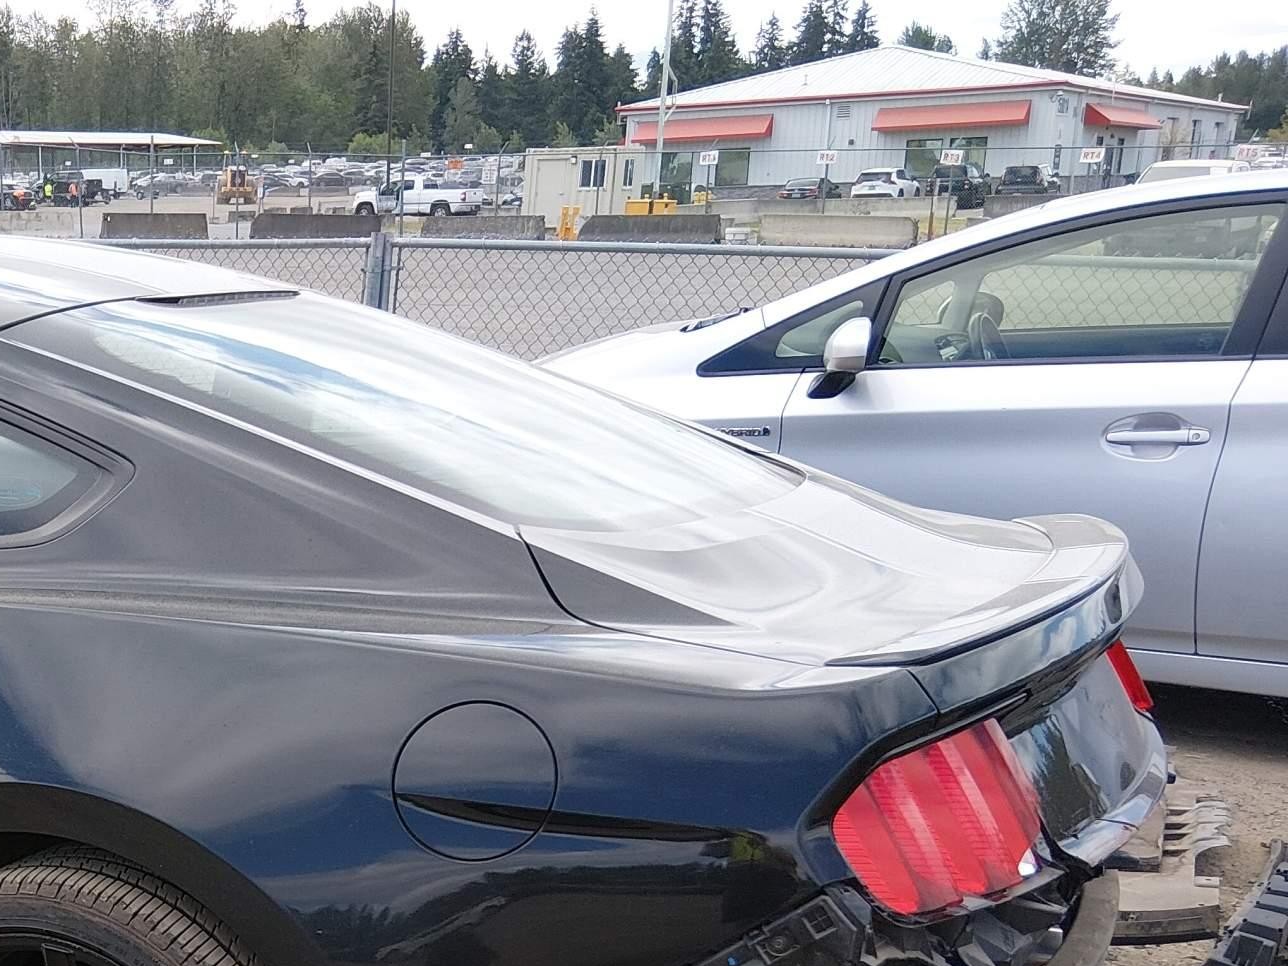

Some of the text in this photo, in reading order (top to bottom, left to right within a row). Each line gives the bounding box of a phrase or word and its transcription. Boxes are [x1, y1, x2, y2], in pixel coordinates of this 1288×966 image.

[819, 151, 835, 161] RT2
[1082, 151, 1101, 160] RT4
[716, 427, 762, 438] YBRID
